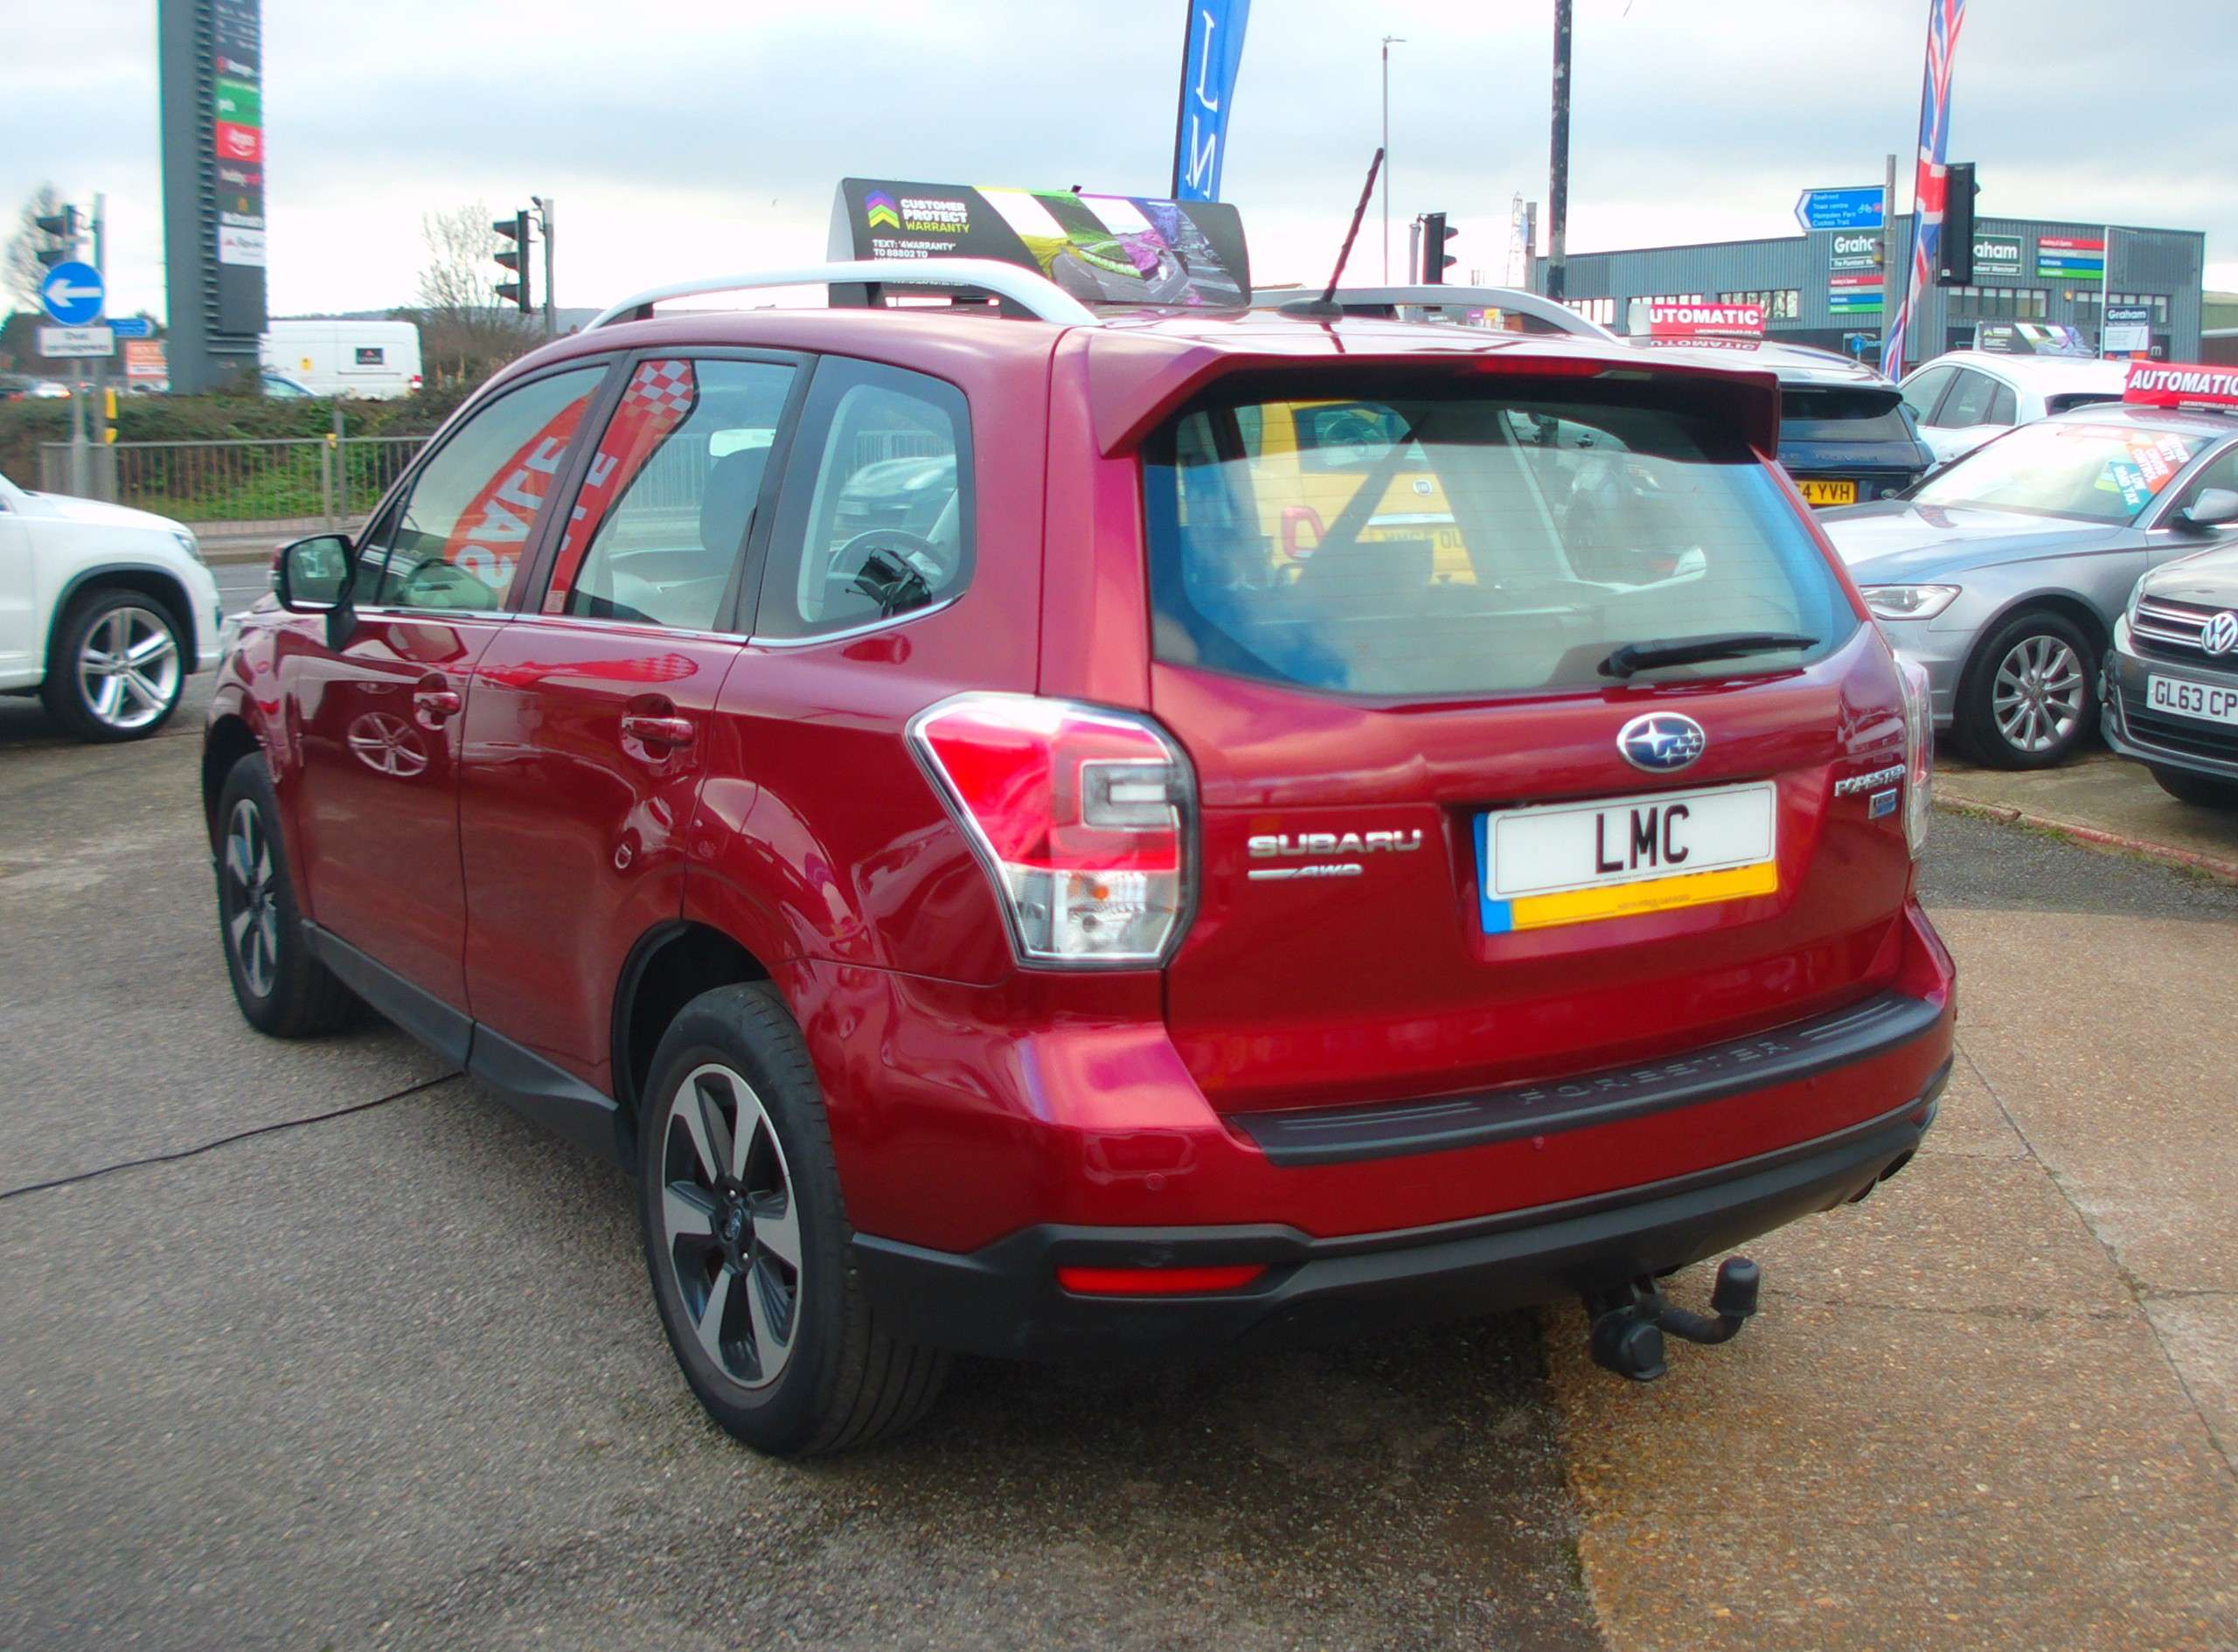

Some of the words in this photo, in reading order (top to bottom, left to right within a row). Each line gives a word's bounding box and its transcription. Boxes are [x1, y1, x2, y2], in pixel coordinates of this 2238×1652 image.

[900, 199, 966, 211] CUSTOMER
[903, 209, 967, 223] PROTECT
[906, 221, 970, 233] WARRANTY
[1834, 235, 1875, 253] Grah
[1973, 241, 2018, 260] aham
[1650, 308, 1759, 325] UTOMATIC
[2108, 309, 2146, 320] Graham
[1818, 484, 1850, 501] YVH
[2155, 681, 2203, 712] GL63
[1248, 829, 1421, 857] SUBARU
[1596, 804, 1689, 875] LMC
